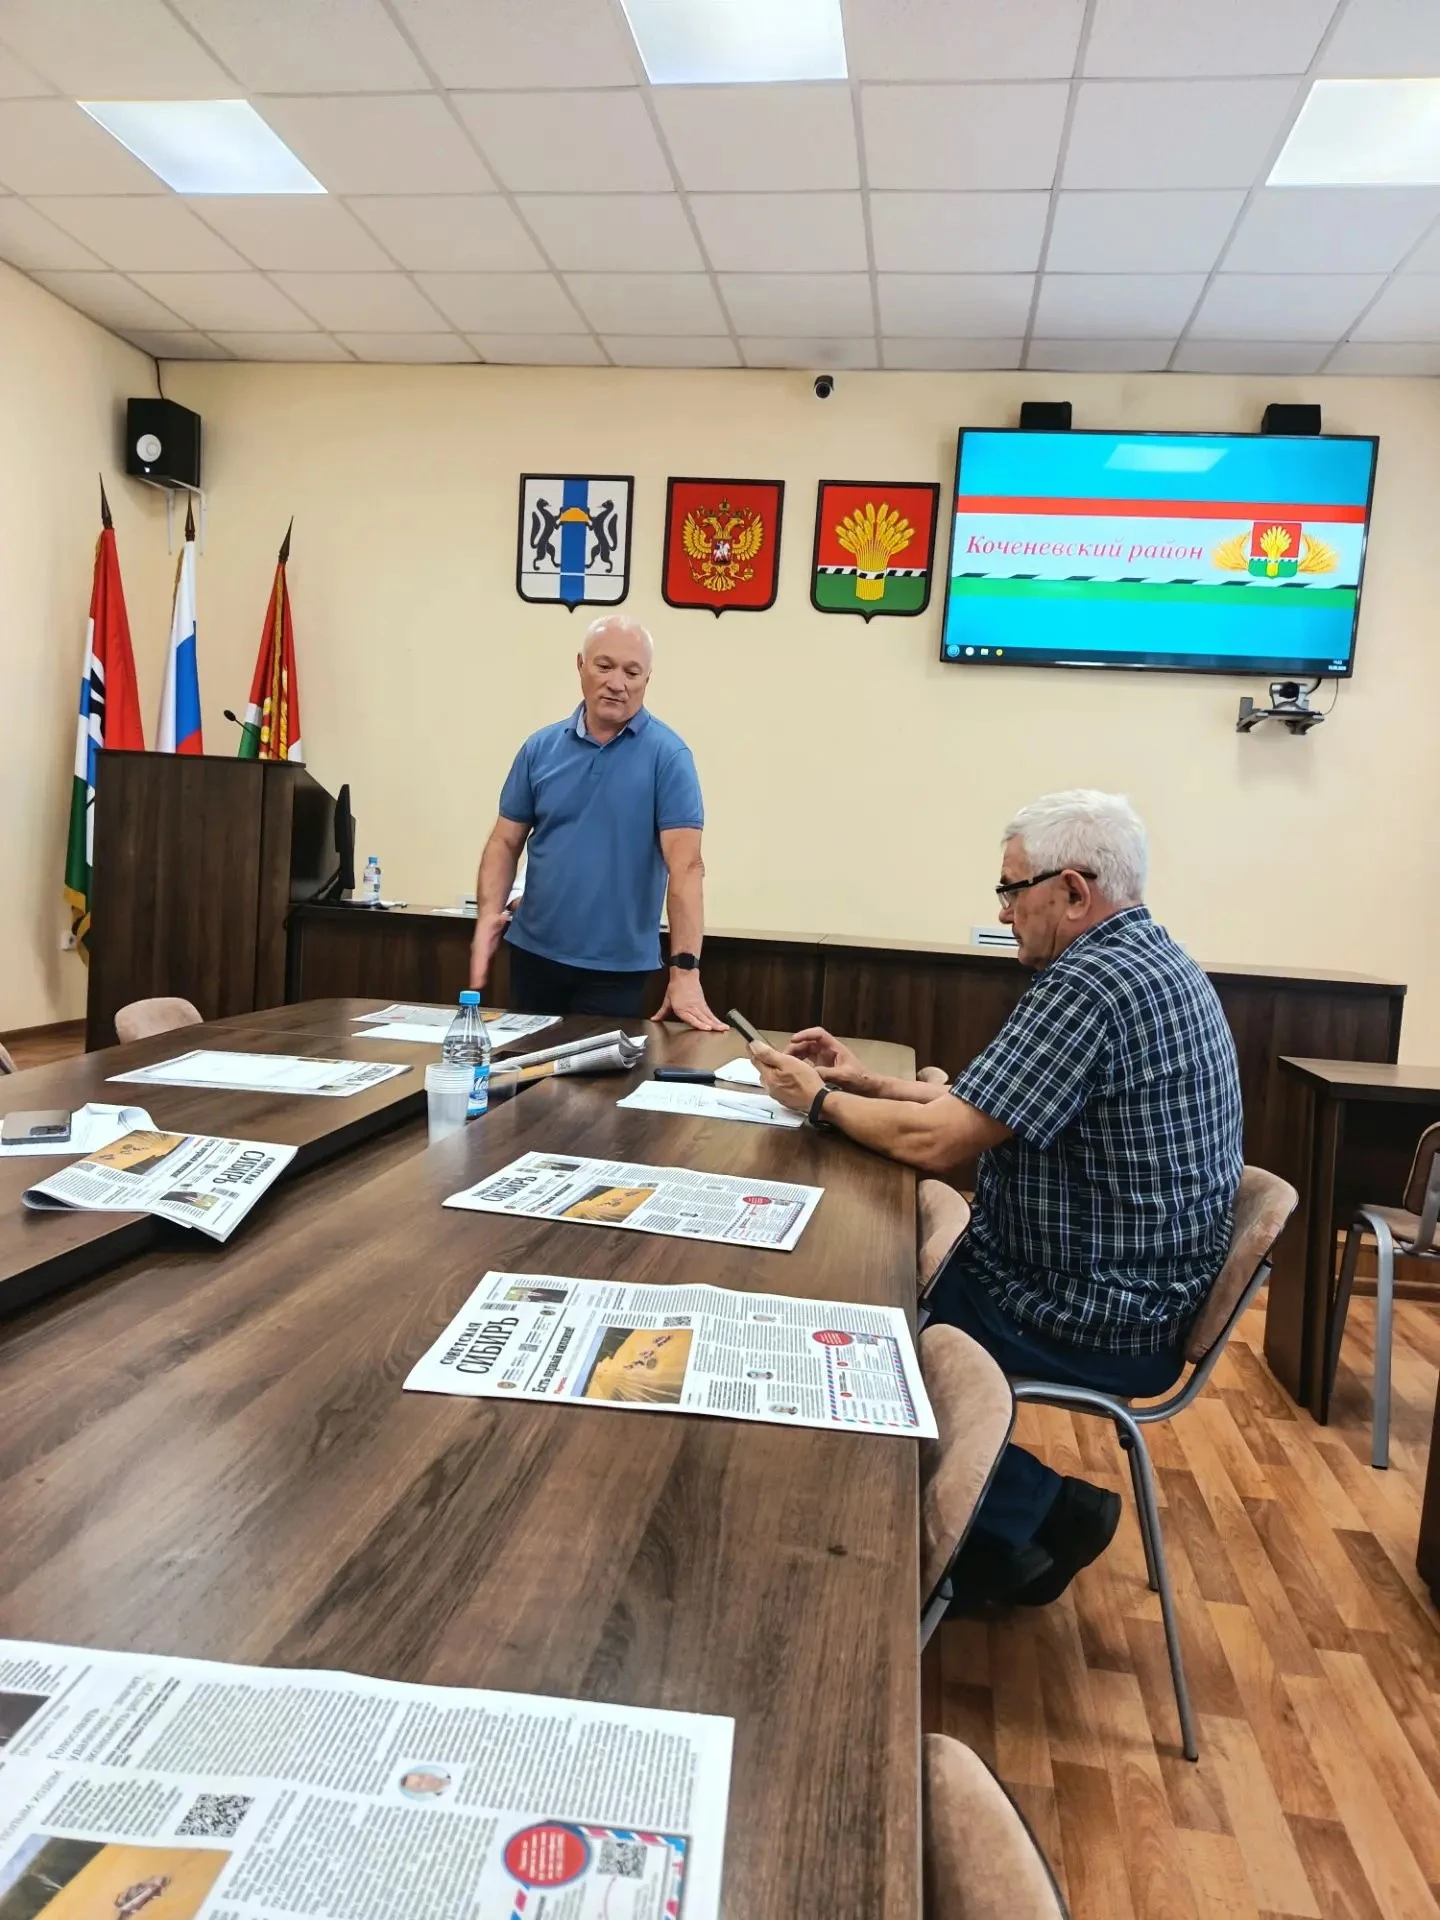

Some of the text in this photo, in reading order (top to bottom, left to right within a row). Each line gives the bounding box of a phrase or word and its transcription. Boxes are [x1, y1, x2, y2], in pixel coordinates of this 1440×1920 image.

[966, 535, 1204, 563] Коченевский район
[212, 1150, 265, 1184] СИБИРЬ
[480, 1176, 538, 1201] СИБИРЬ
[440, 1322, 482, 1365] СОВЕТСКАЯ
[456, 1317, 520, 1374] СИБИРЬ
[532, 1377, 551, 1393] Есть
